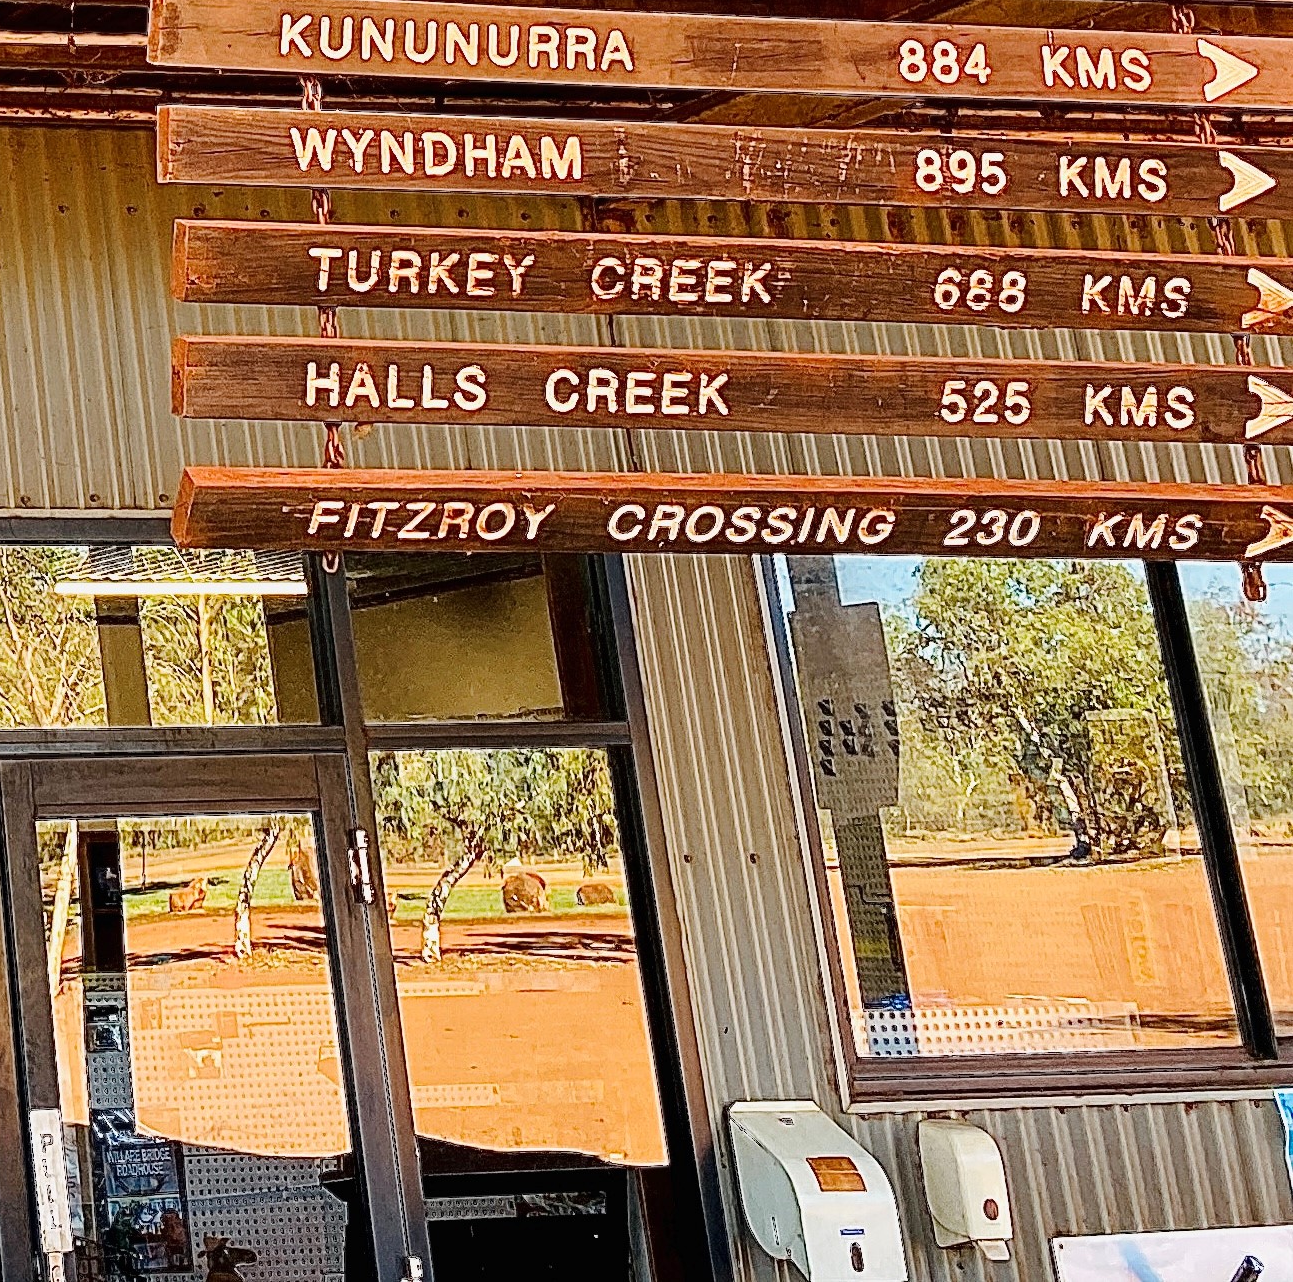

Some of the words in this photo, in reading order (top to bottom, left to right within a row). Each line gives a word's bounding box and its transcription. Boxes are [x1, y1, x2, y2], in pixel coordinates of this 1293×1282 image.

[278, 13, 635, 73] KUNUNURRA
[897, 37, 994, 86] 884
[1039, 43, 1154, 94] KMS
[289, 126, 584, 181] WYNDHAM
[913, 147, 1009, 197] 895
[1057, 153, 1169, 204] KMS
[306, 245, 537, 298] TURKEY
[588, 255, 774, 306] CREEK
[931, 265, 1029, 315] 688
[1079, 271, 1193, 321] KMS
[303, 359, 489, 413] HALLS
[543, 365, 731, 418] CREEK
[938, 378, 1033, 427] 525
[1082, 381, 1197, 431] KMS
[305, 498, 558, 543] FITZROY
[604, 502, 898, 547] CROSSING
[941, 507, 1043, 549] 230
[1085, 510, 1205, 552] KMS
